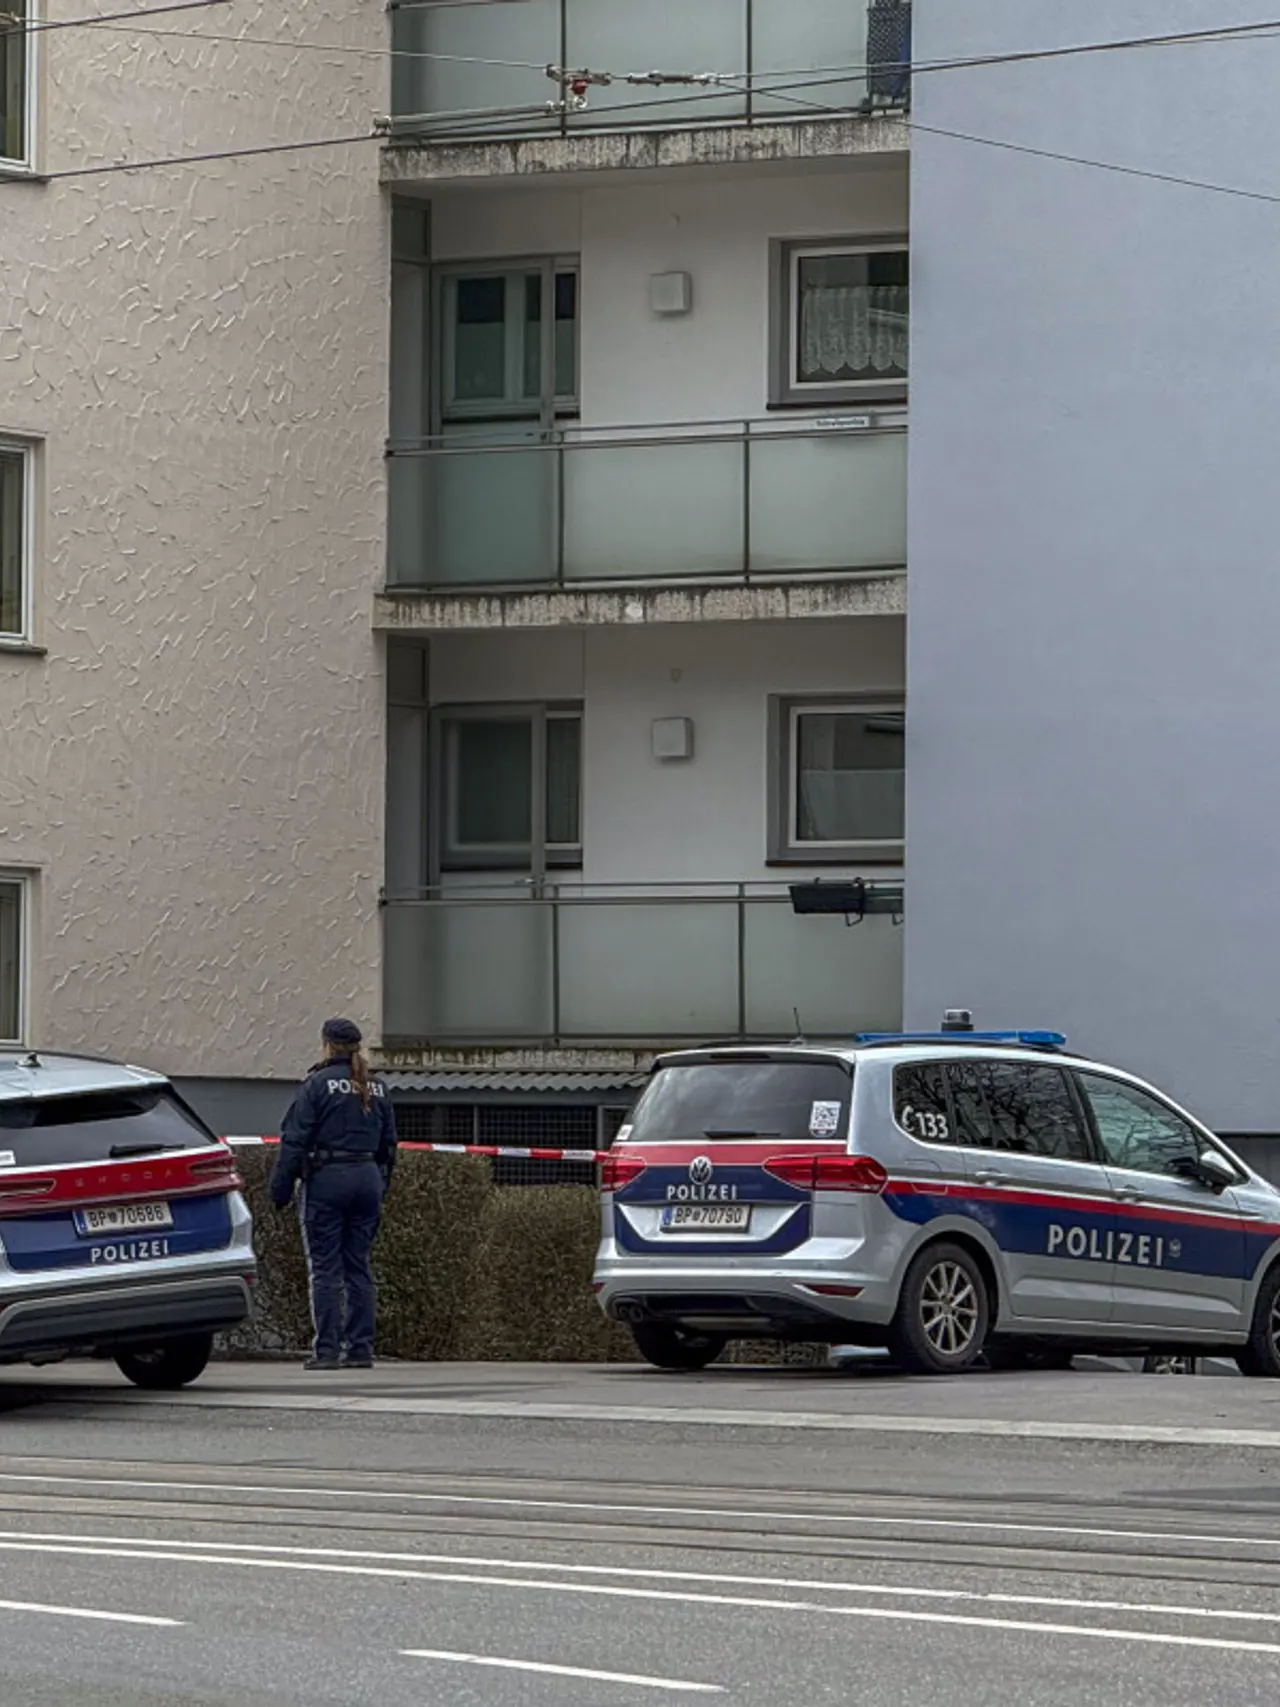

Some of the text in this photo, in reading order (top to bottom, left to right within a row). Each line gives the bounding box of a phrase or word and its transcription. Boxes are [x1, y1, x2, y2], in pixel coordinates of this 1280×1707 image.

[915, 1111, 949, 1139] 133
[666, 1184, 738, 1201] POLIZEI
[674, 1207, 692, 1224] BP
[90, 1239, 169, 1263] POLIZEI
[1047, 1224, 1164, 1266] POLIZEI
